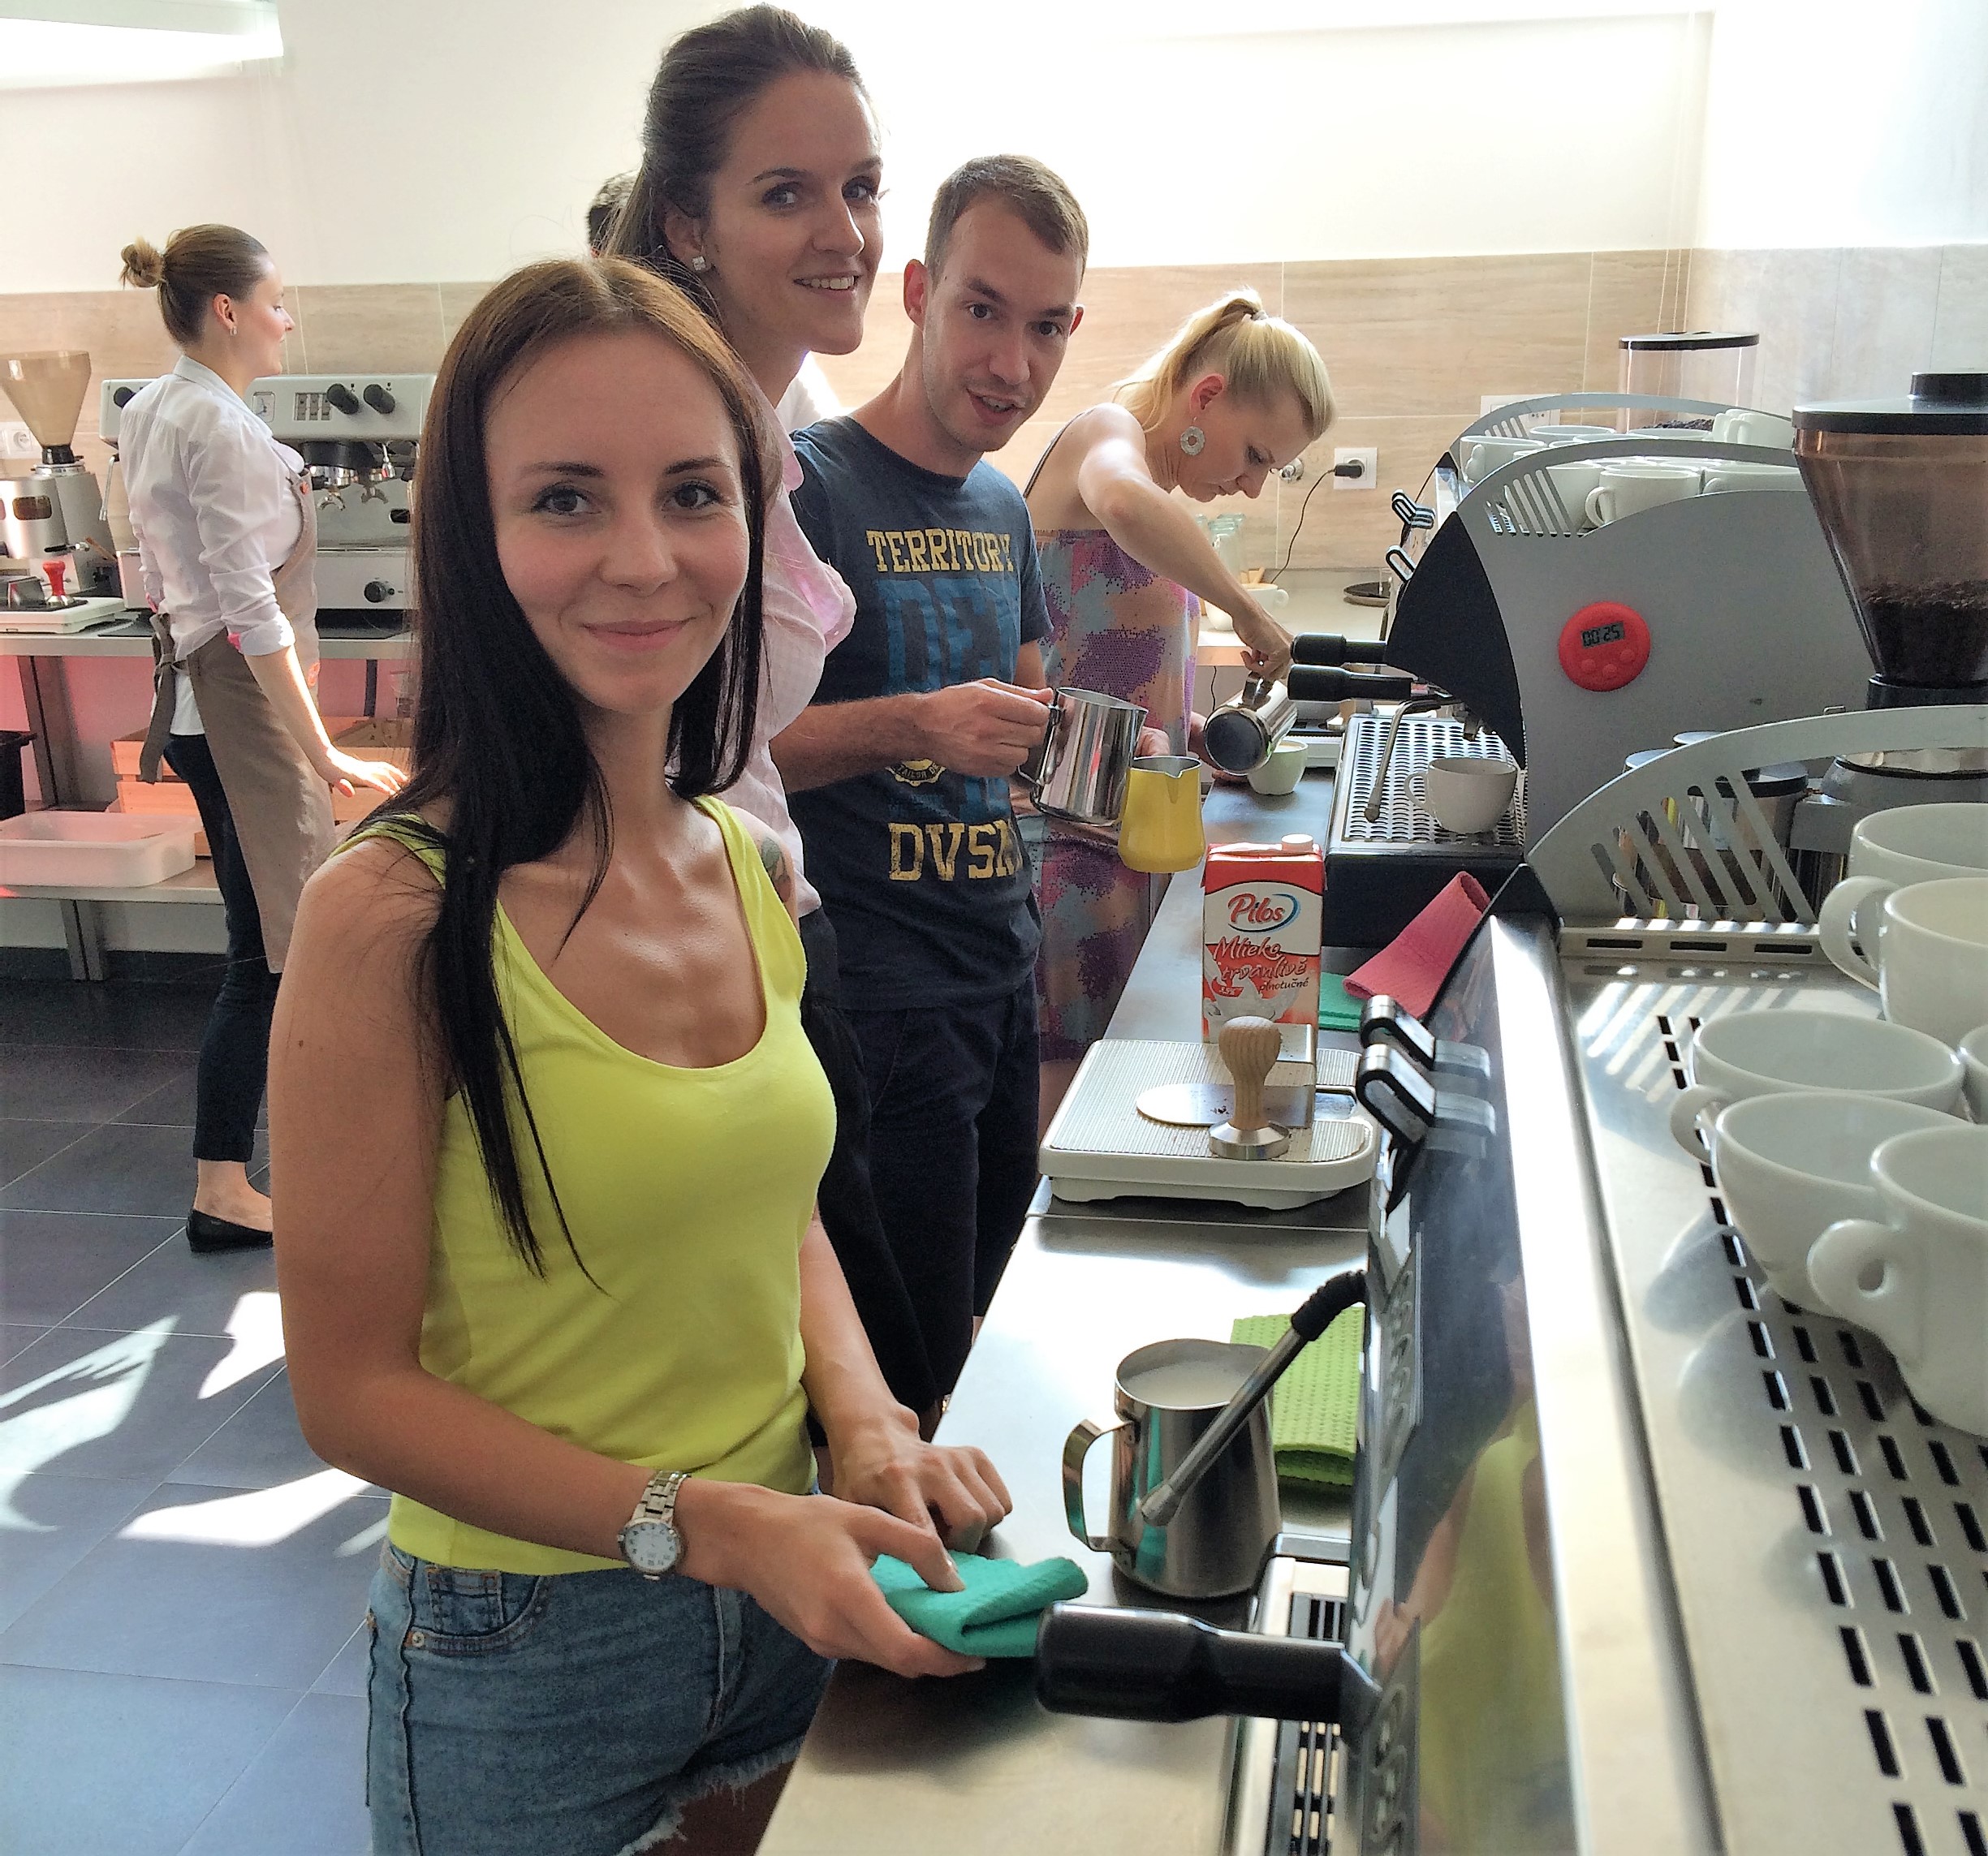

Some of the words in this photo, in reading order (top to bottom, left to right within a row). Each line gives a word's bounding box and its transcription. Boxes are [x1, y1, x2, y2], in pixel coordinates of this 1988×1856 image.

[866, 529, 1014, 572] TERRITORY
[1227, 893, 1285, 924] Pilos
[1213, 935, 1282, 961] Mlieko
